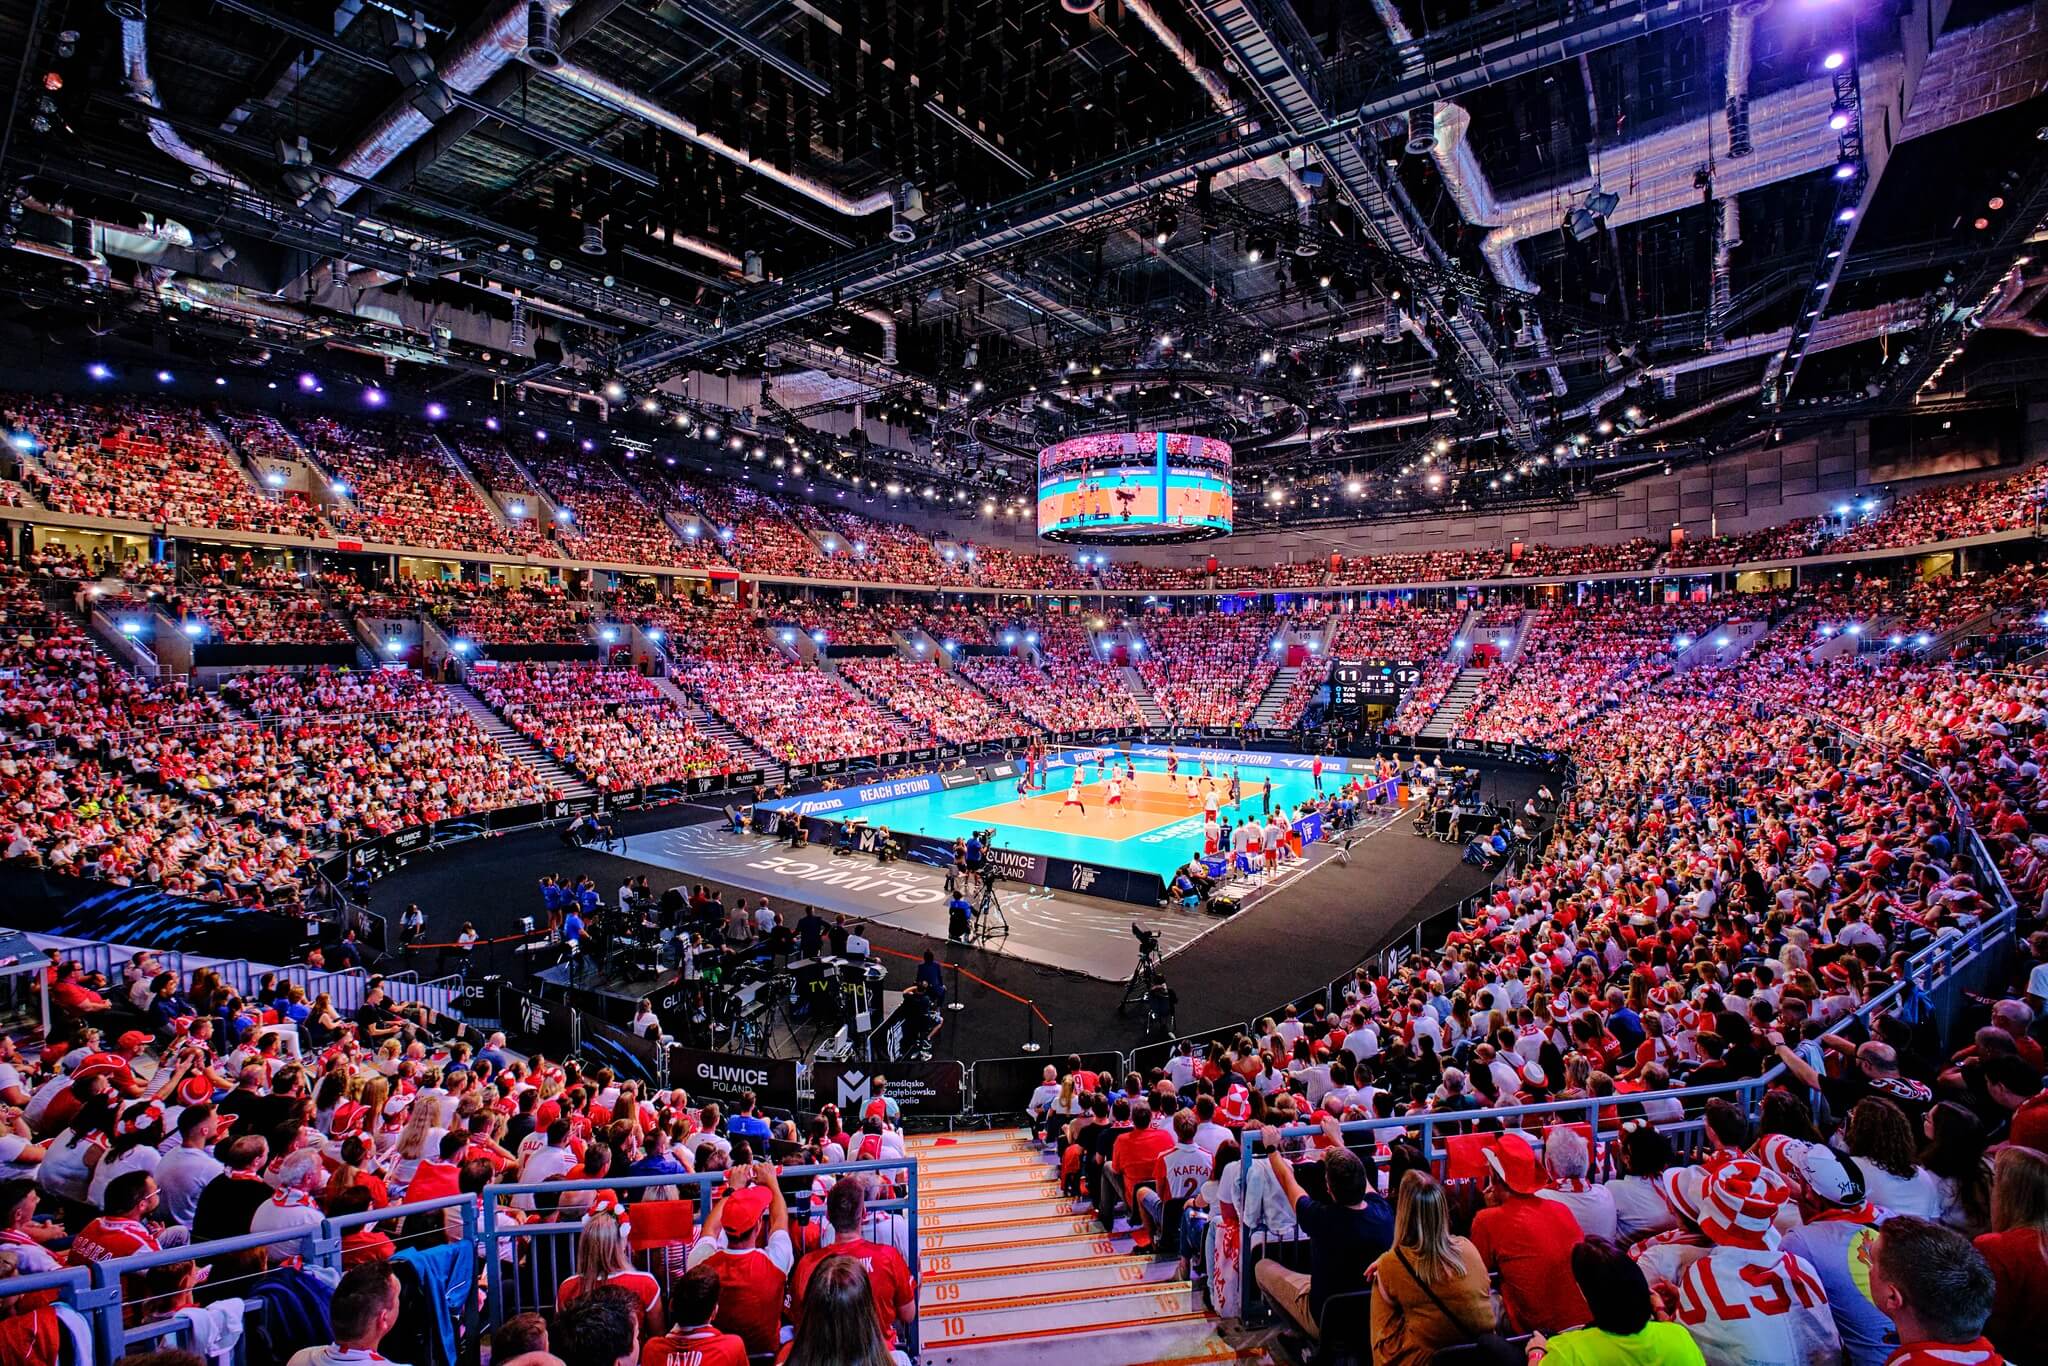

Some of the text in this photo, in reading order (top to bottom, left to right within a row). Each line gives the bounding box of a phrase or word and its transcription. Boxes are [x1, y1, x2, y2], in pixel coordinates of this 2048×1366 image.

[384, 623, 402, 634] 1-19
[1338, 670, 1357, 681] 11
[1397, 670, 1420, 682] 12
[735, 773, 758, 782] GLIWICE
[612, 792, 635, 802] GLIWICE
[860, 787, 892, 802] REACH
[893, 779, 930, 796] BEYOND
[395, 830, 422, 845] GLIWICE
[986, 850, 1036, 870] GLIWICE
[828, 858, 932, 883] POLAND
[745, 856, 946, 904] GLIWICE
[809, 981, 829, 993] TV
[696, 1063, 769, 1086] GLIWICE
[1173, 1165, 1210, 1177] KAFKA
[1184, 1177, 1198, 1198] 2
[920, 1199, 936, 1209] 05
[923, 1216, 940, 1226] 06
[1072, 1222, 1091, 1235] 07
[926, 1235, 944, 1249] 07
[1091, 1241, 1115, 1255] 08
[929, 1256, 951, 1272] 08
[1119, 1265, 1144, 1282] 09
[935, 1284, 960, 1301] 09
[941, 1317, 965, 1337] 10
